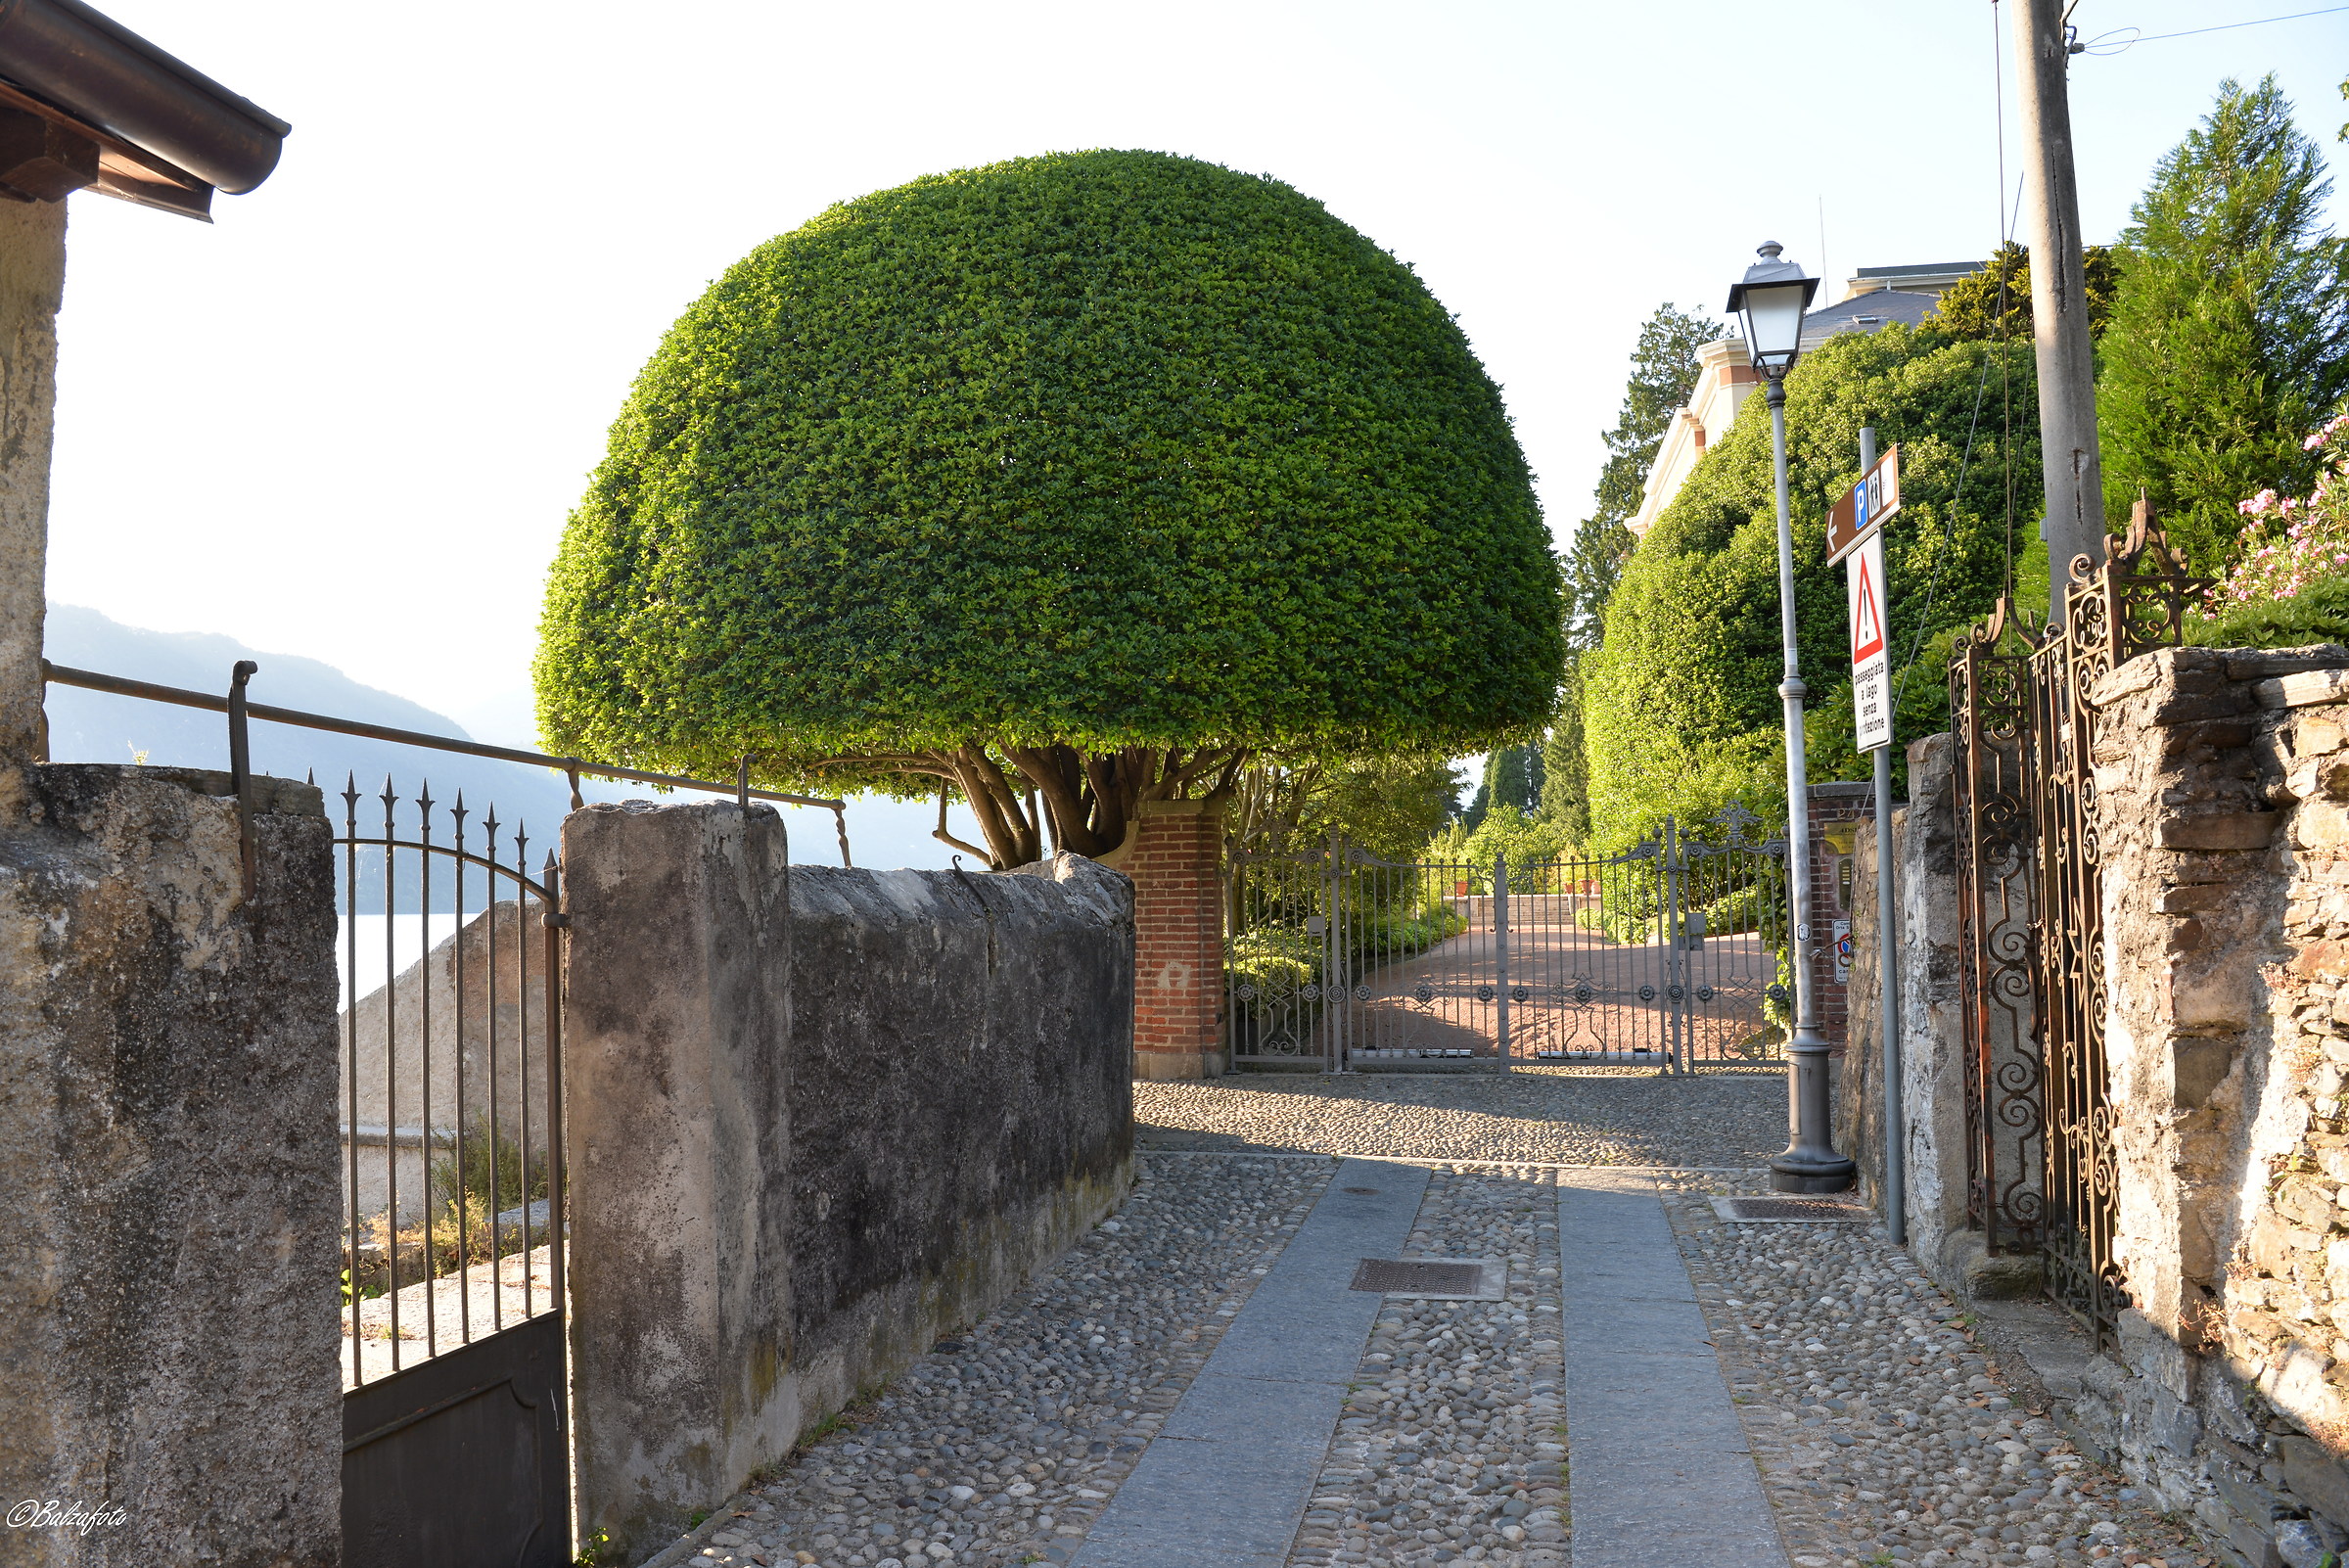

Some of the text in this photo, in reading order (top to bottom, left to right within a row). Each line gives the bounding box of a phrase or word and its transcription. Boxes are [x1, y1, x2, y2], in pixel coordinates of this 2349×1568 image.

[1857, 488, 1865, 523] P
[1855, 660, 1884, 688] passeggiata
[1861, 684, 1878, 701] a lago
[1863, 702, 1877, 717] senza
